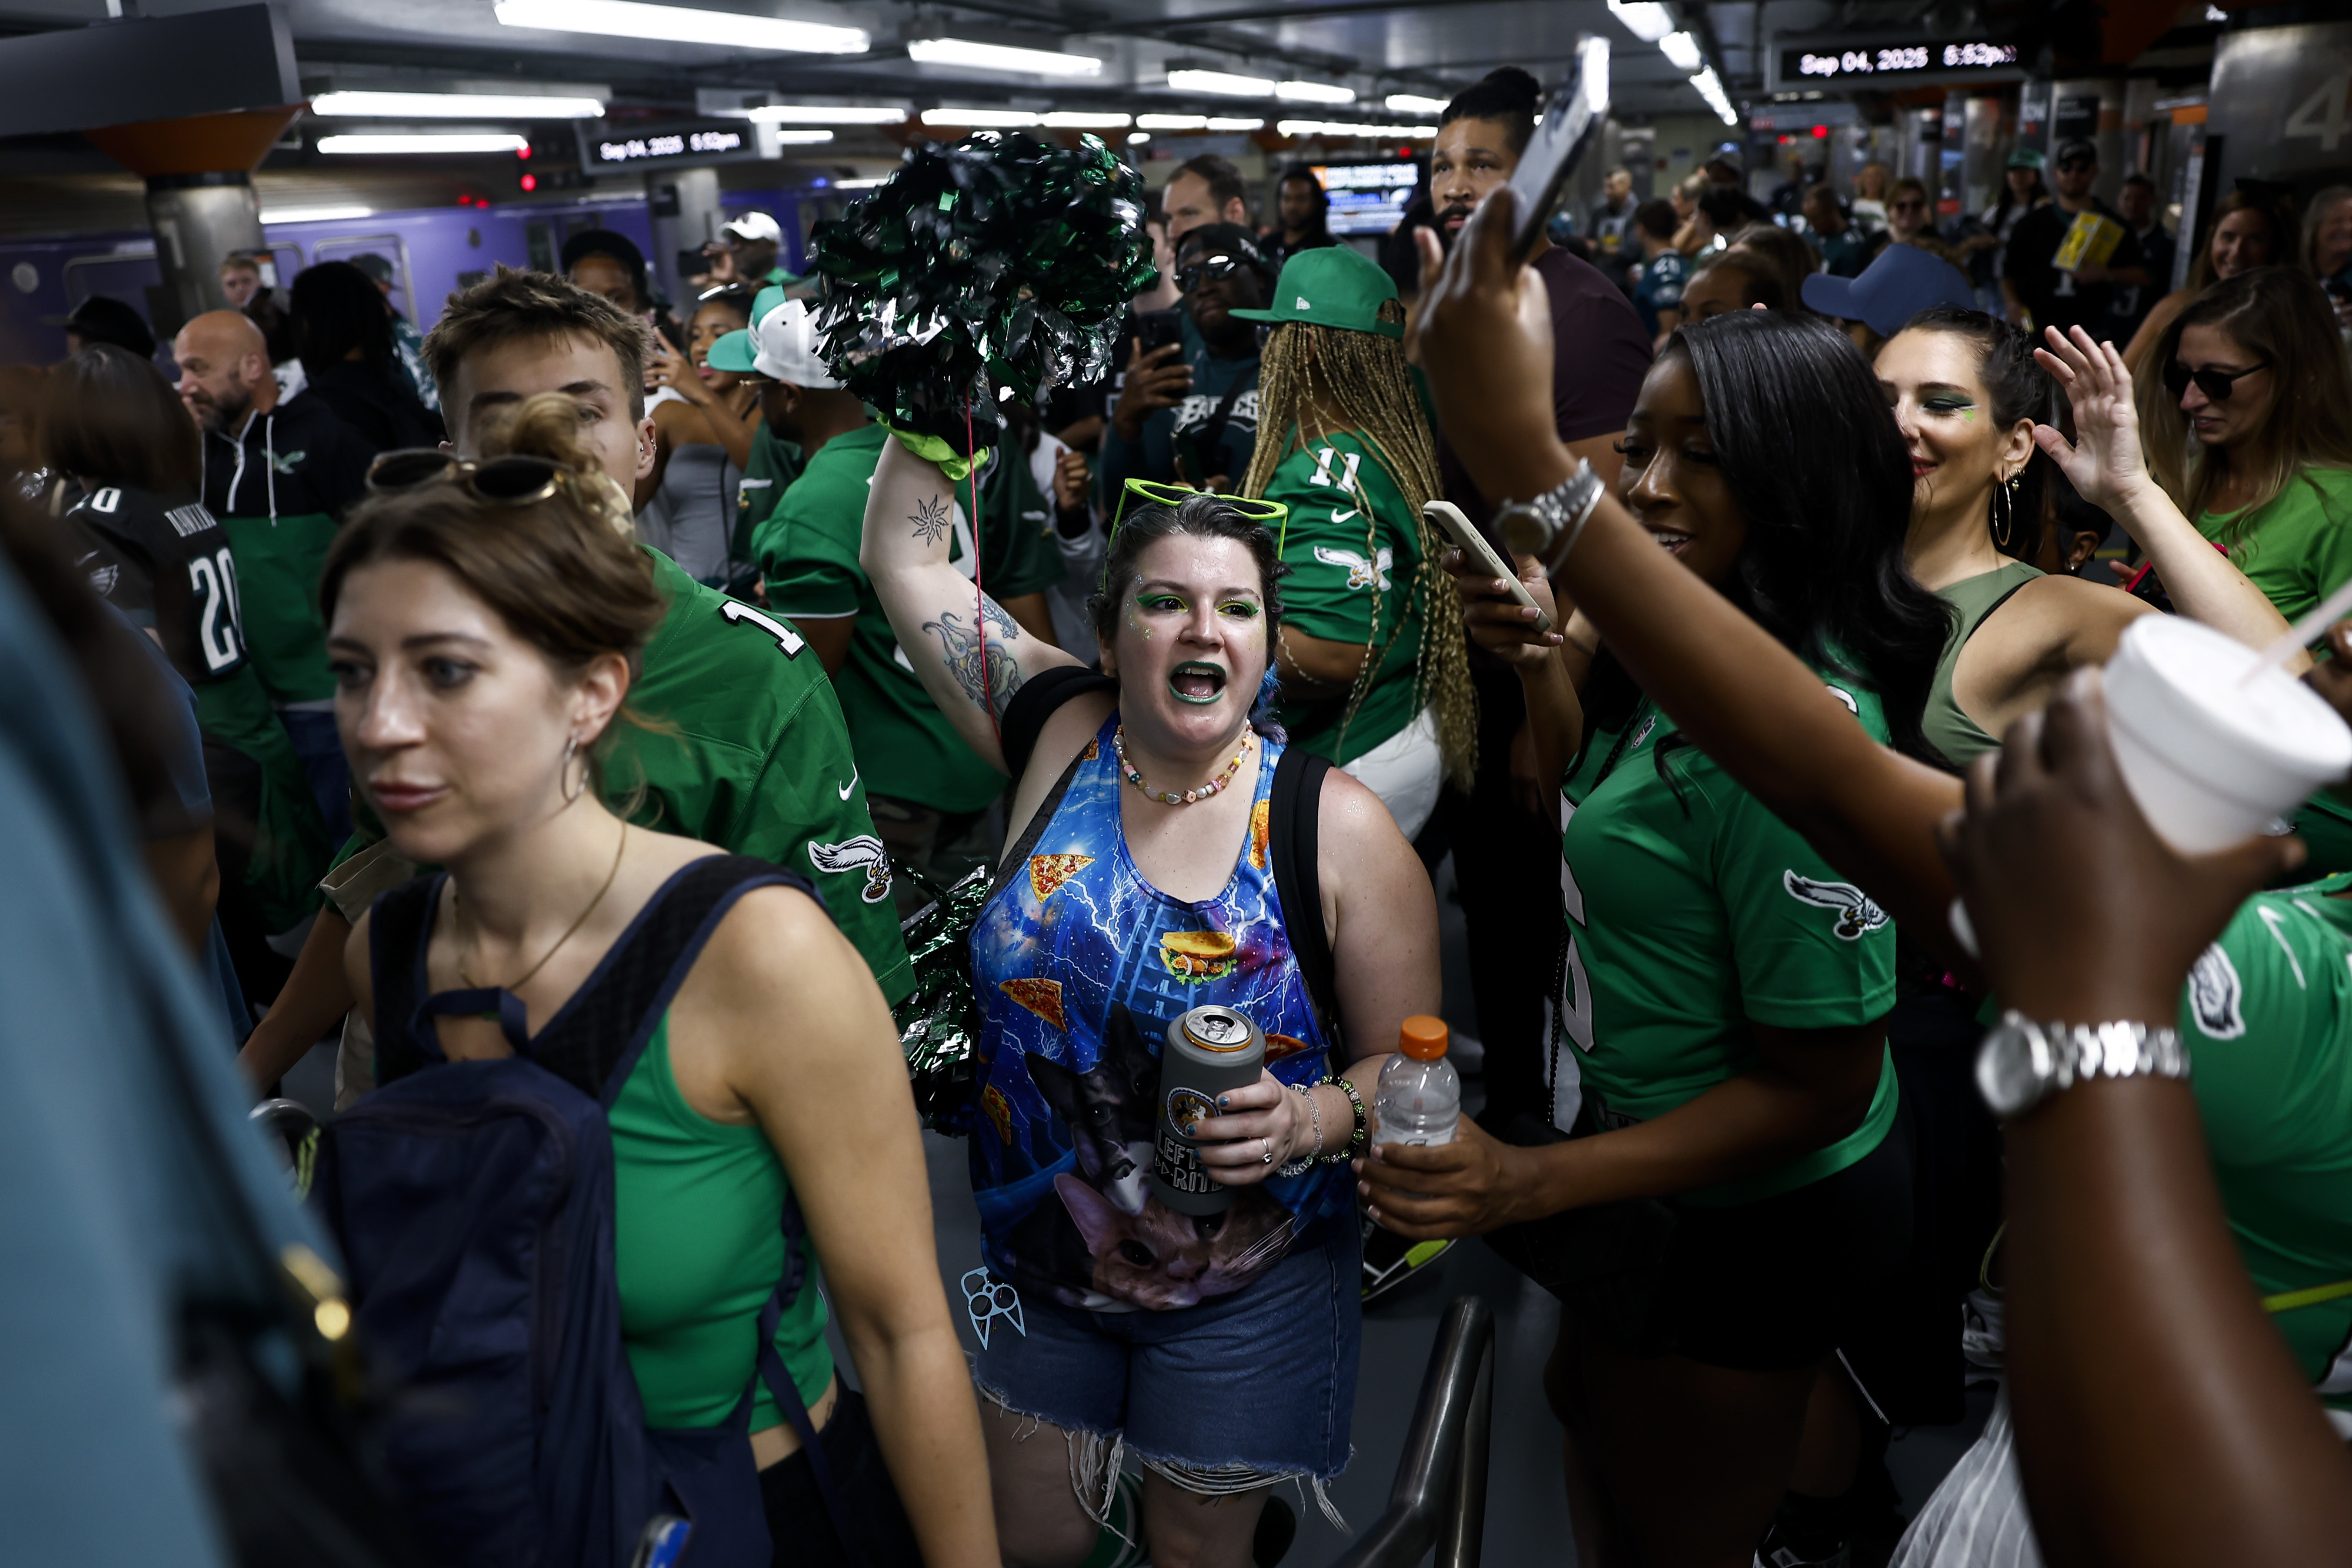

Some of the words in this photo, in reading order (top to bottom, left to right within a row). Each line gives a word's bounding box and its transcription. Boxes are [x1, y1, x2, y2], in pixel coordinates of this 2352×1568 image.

[1799, 54, 1840, 78] Sep
[1876, 46, 1929, 71] 2025
[2286, 73, 2352, 151] 4
[600, 142, 627, 162] Sep
[647, 134, 684, 156] 2025
[1309, 447, 1362, 494] 11
[719, 599, 807, 661] 1
